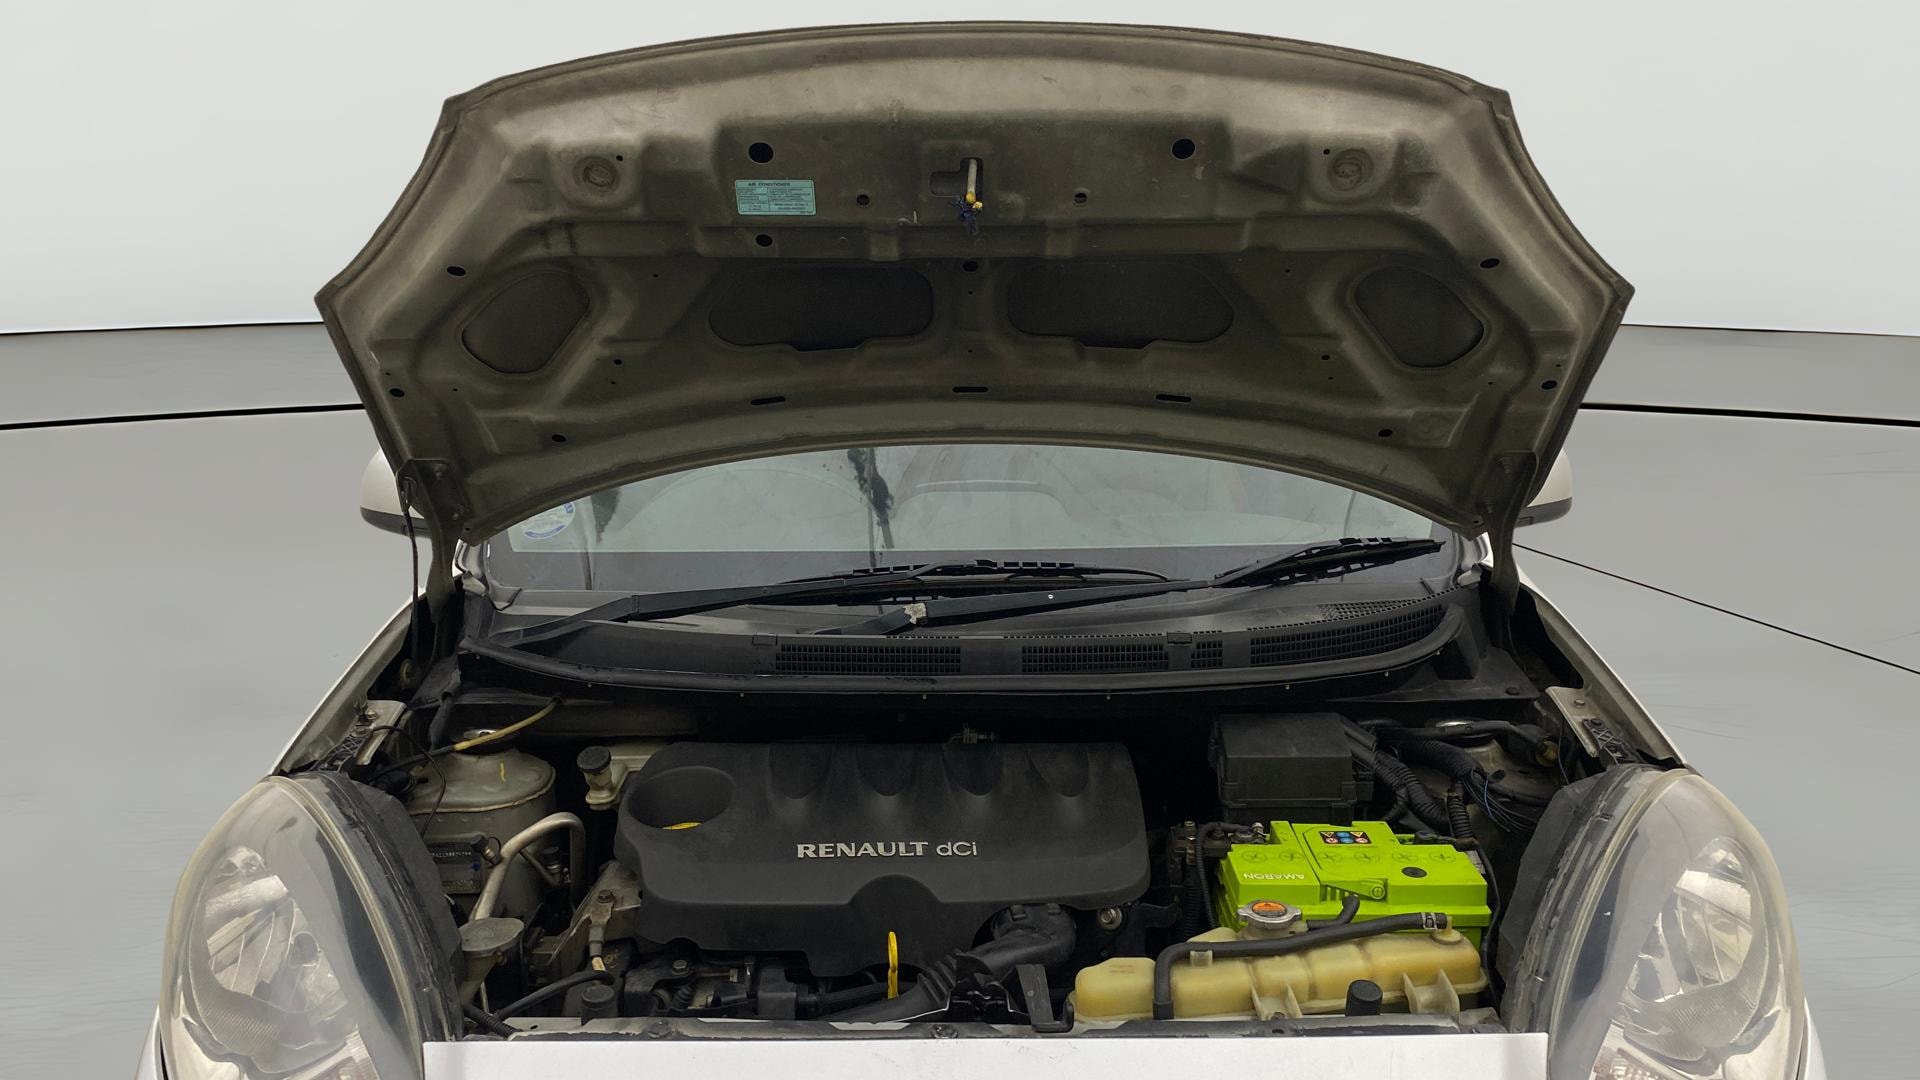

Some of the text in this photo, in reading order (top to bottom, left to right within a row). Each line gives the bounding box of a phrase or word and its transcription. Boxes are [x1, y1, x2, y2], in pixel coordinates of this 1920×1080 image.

[797, 841, 977, 858] RENAULT dCi
[1243, 872, 1305, 880] AMARON
